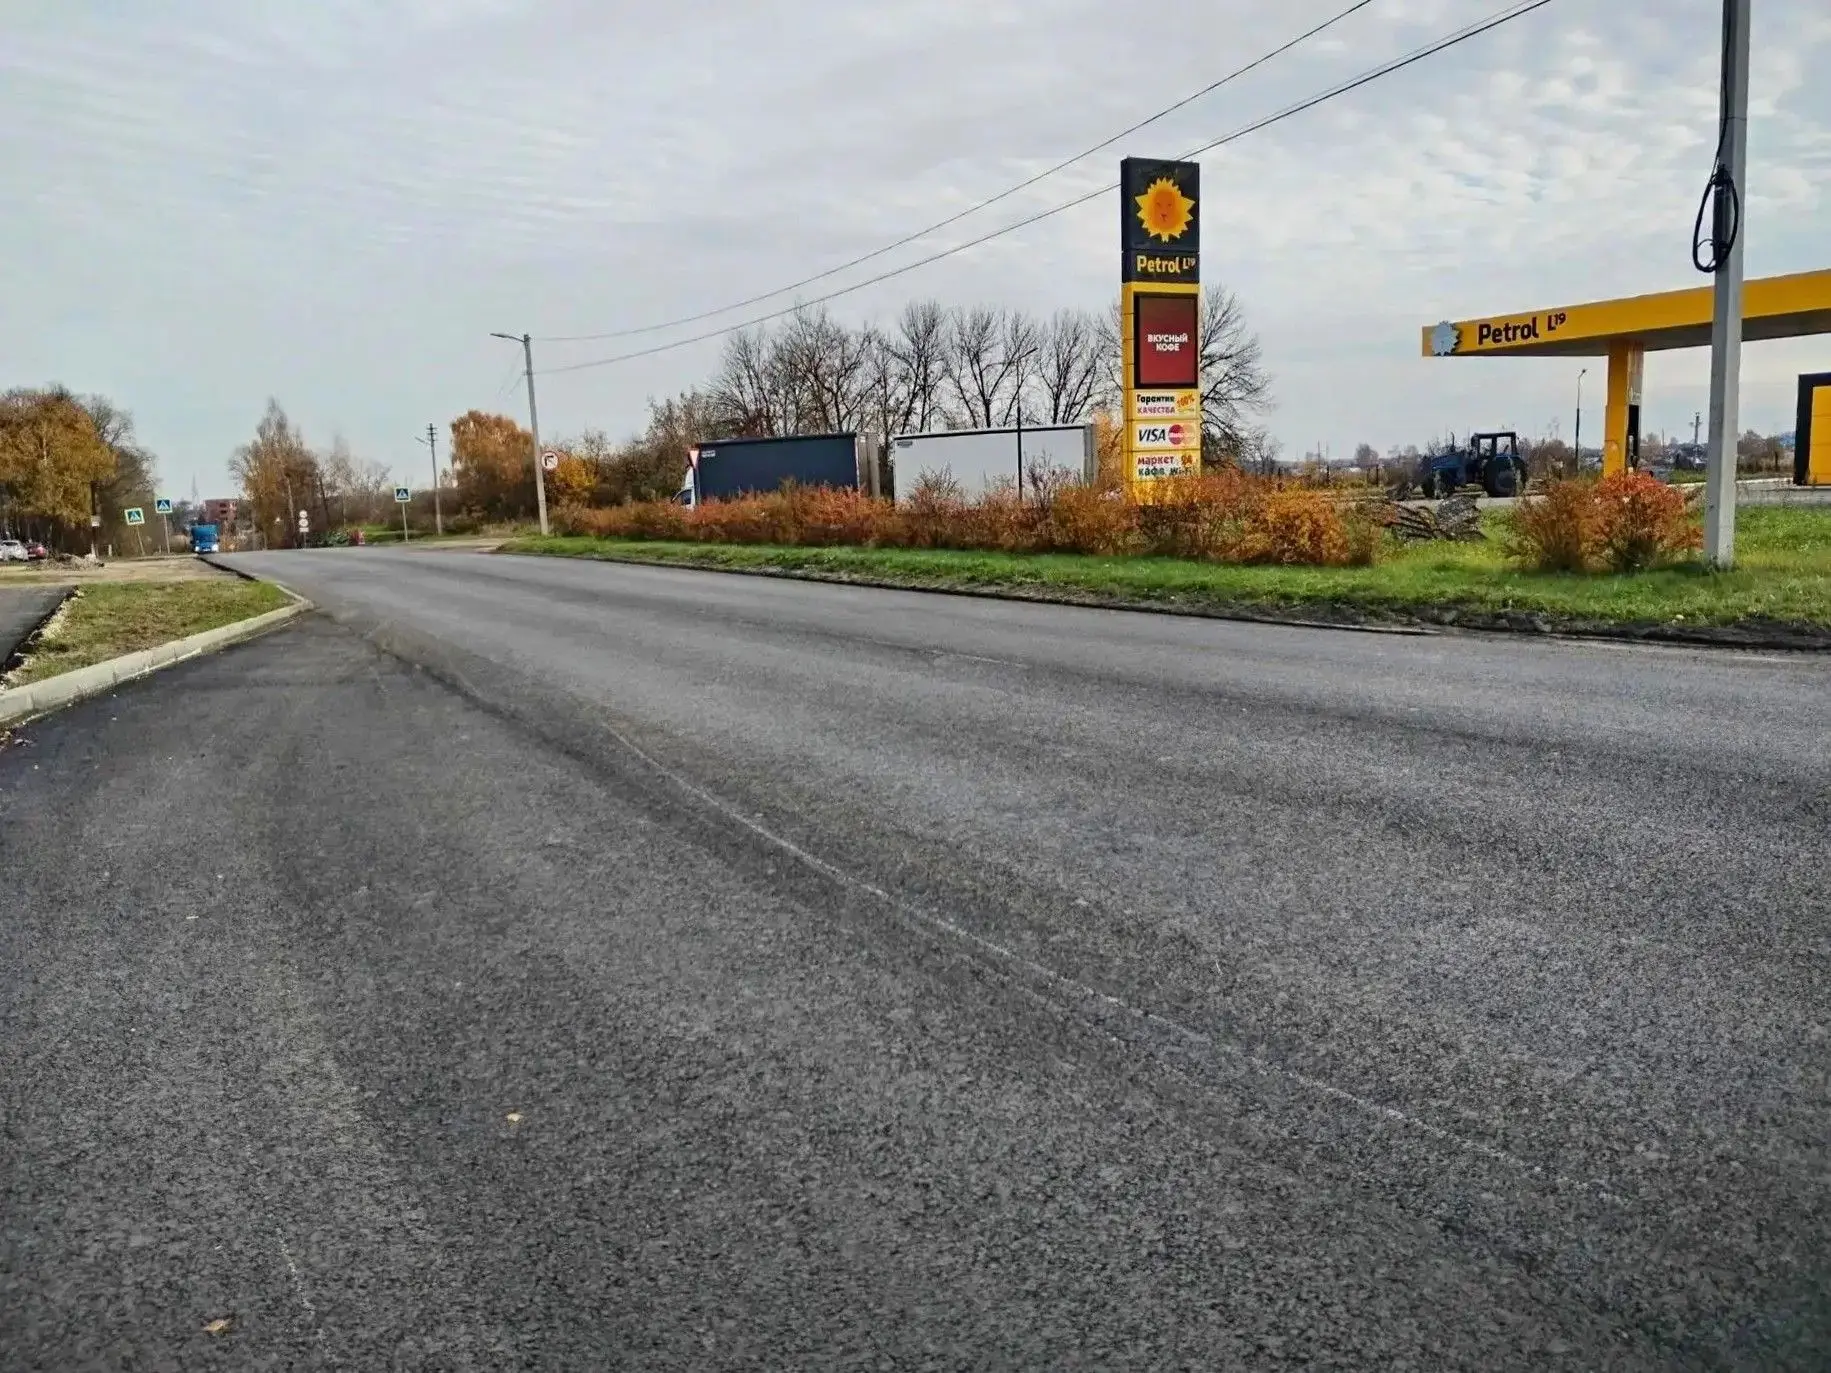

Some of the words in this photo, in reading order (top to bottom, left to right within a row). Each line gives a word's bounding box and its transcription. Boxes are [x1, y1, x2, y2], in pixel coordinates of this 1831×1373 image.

[1136, 255, 1181, 273] Petrol
[1478, 316, 1540, 345] Petrol
[1547, 312, 1567, 331] L19
[1147, 332, 1188, 342] ВКУСНЫЙ
[1156, 343, 1180, 351] КОФЕ
[1138, 428, 1166, 442] VISA
